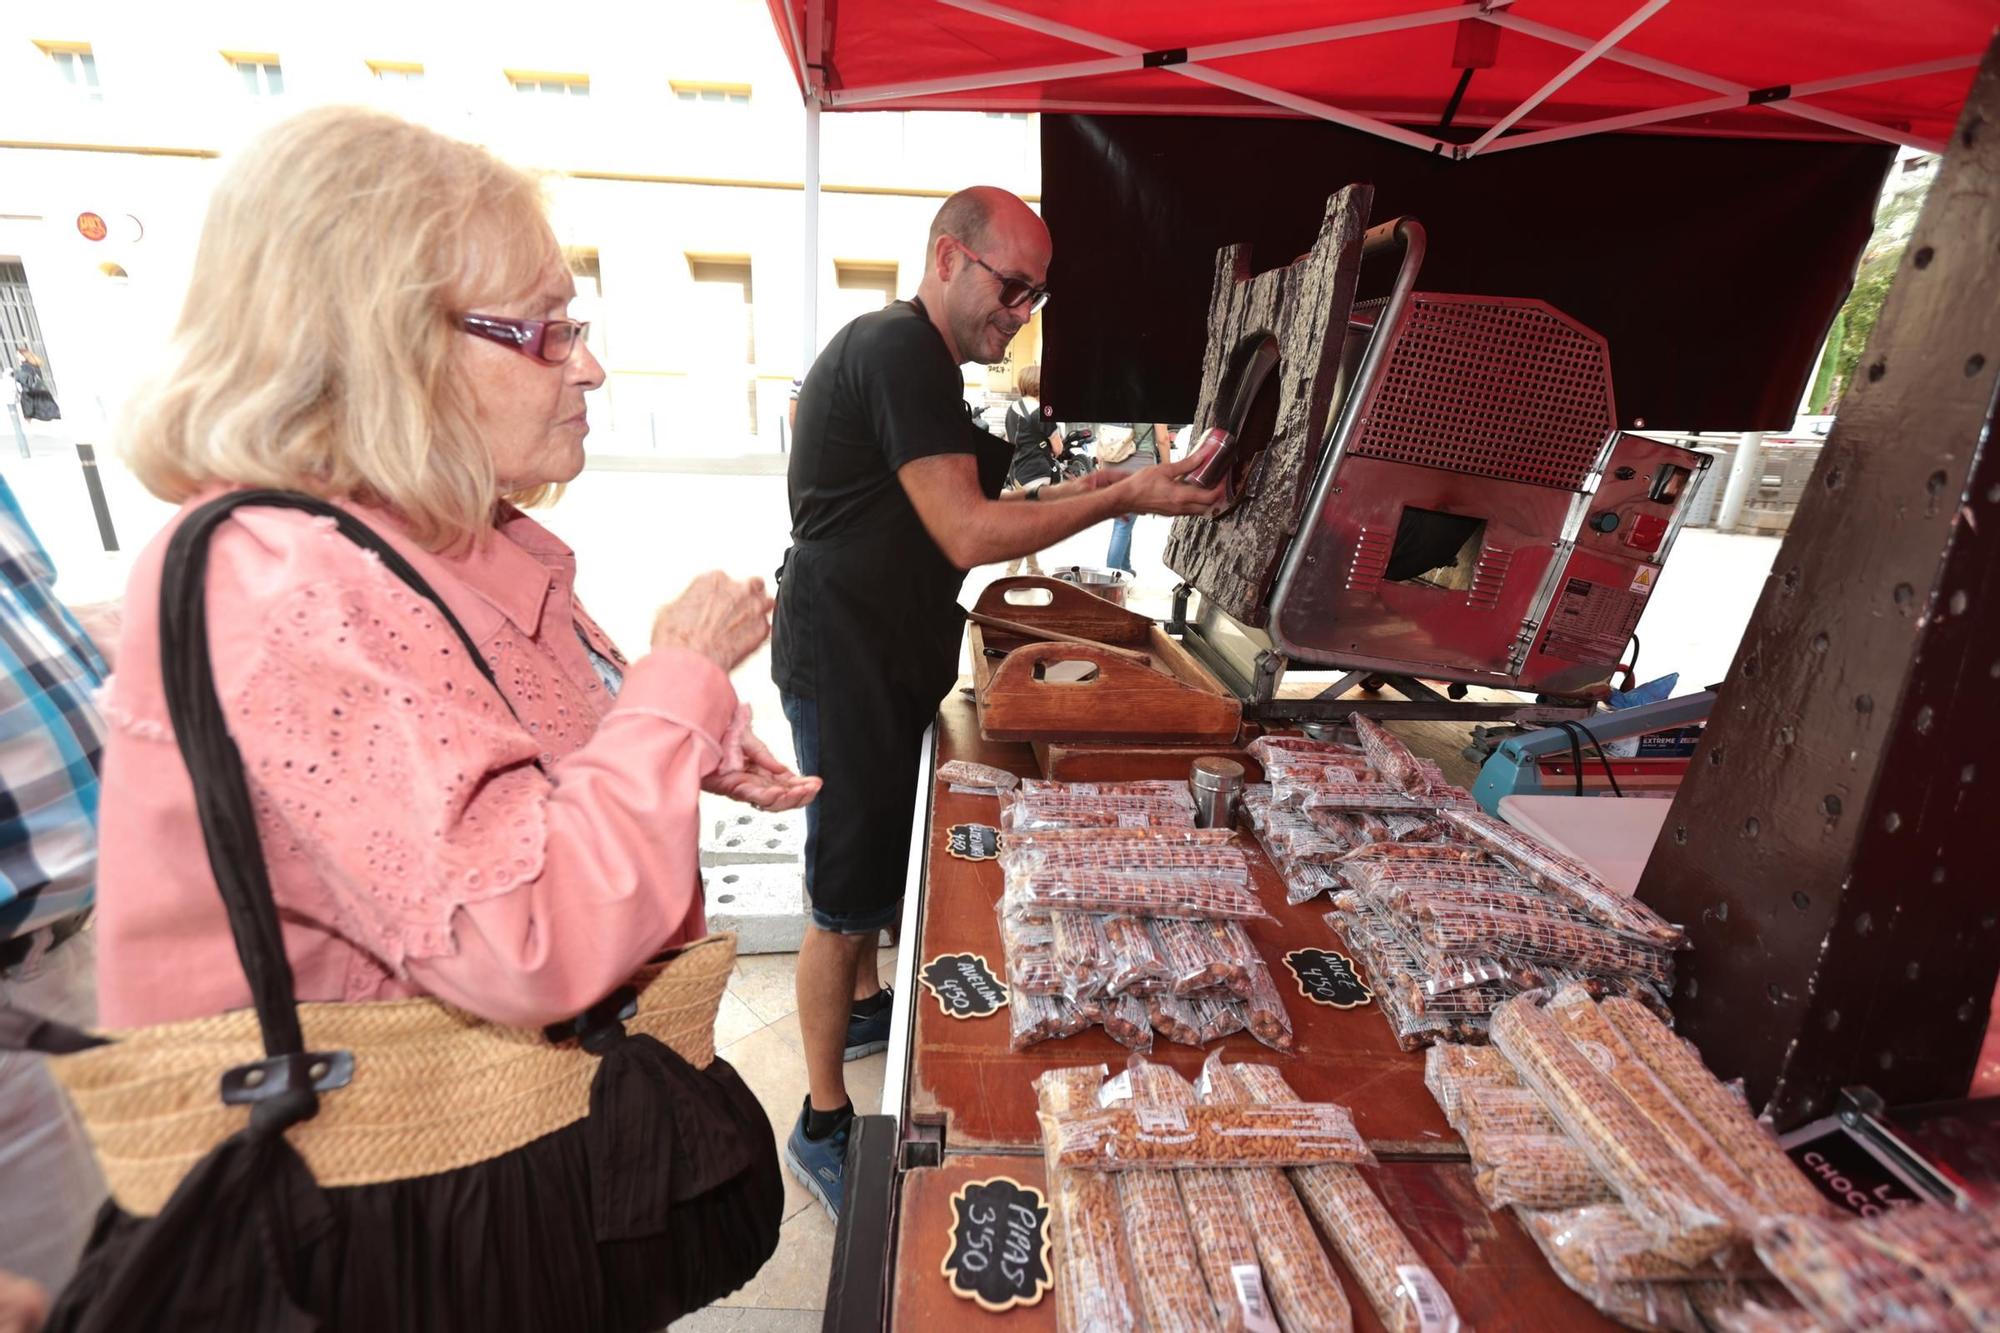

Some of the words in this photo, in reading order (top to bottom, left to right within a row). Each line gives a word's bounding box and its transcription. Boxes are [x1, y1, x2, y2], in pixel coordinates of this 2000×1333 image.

[1642, 737, 1676, 745] EXTREME
[1320, 955, 1357, 989] NUEZ
[962, 1203, 996, 1272] 3'50
[1000, 1203, 1037, 1288] PIPAS
